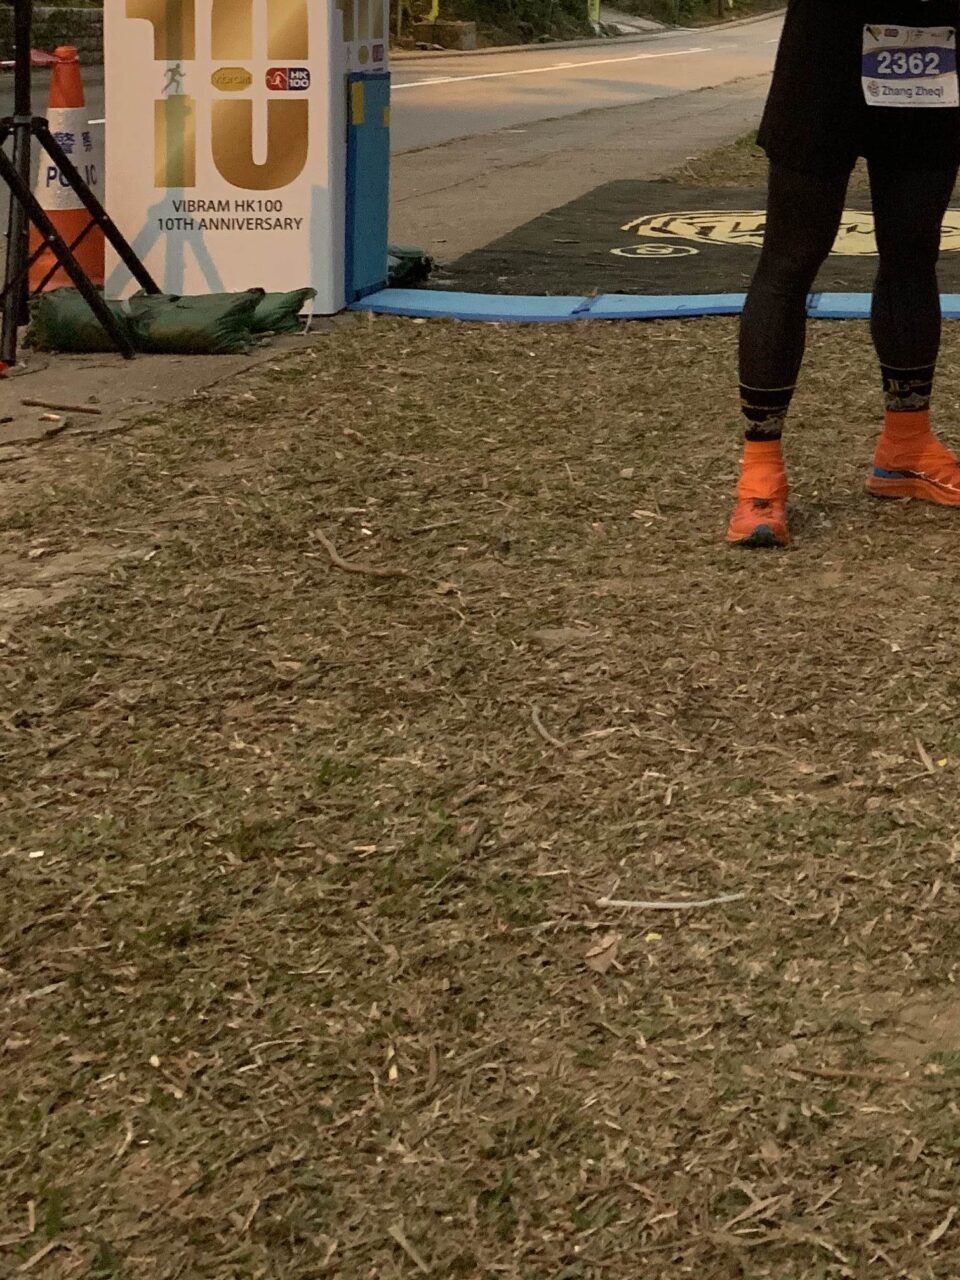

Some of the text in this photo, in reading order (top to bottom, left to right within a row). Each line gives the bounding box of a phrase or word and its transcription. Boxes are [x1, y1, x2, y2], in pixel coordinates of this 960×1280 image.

[877, 50, 941, 75] 2362
[290, 70, 308, 79] HK
[290, 78, 309, 88] 100
[882, 84, 913, 99] Zhang
[172, 199, 283, 213] VIBRAM HK100
[158, 217, 304, 232] 10TH ANNIVERSARY
